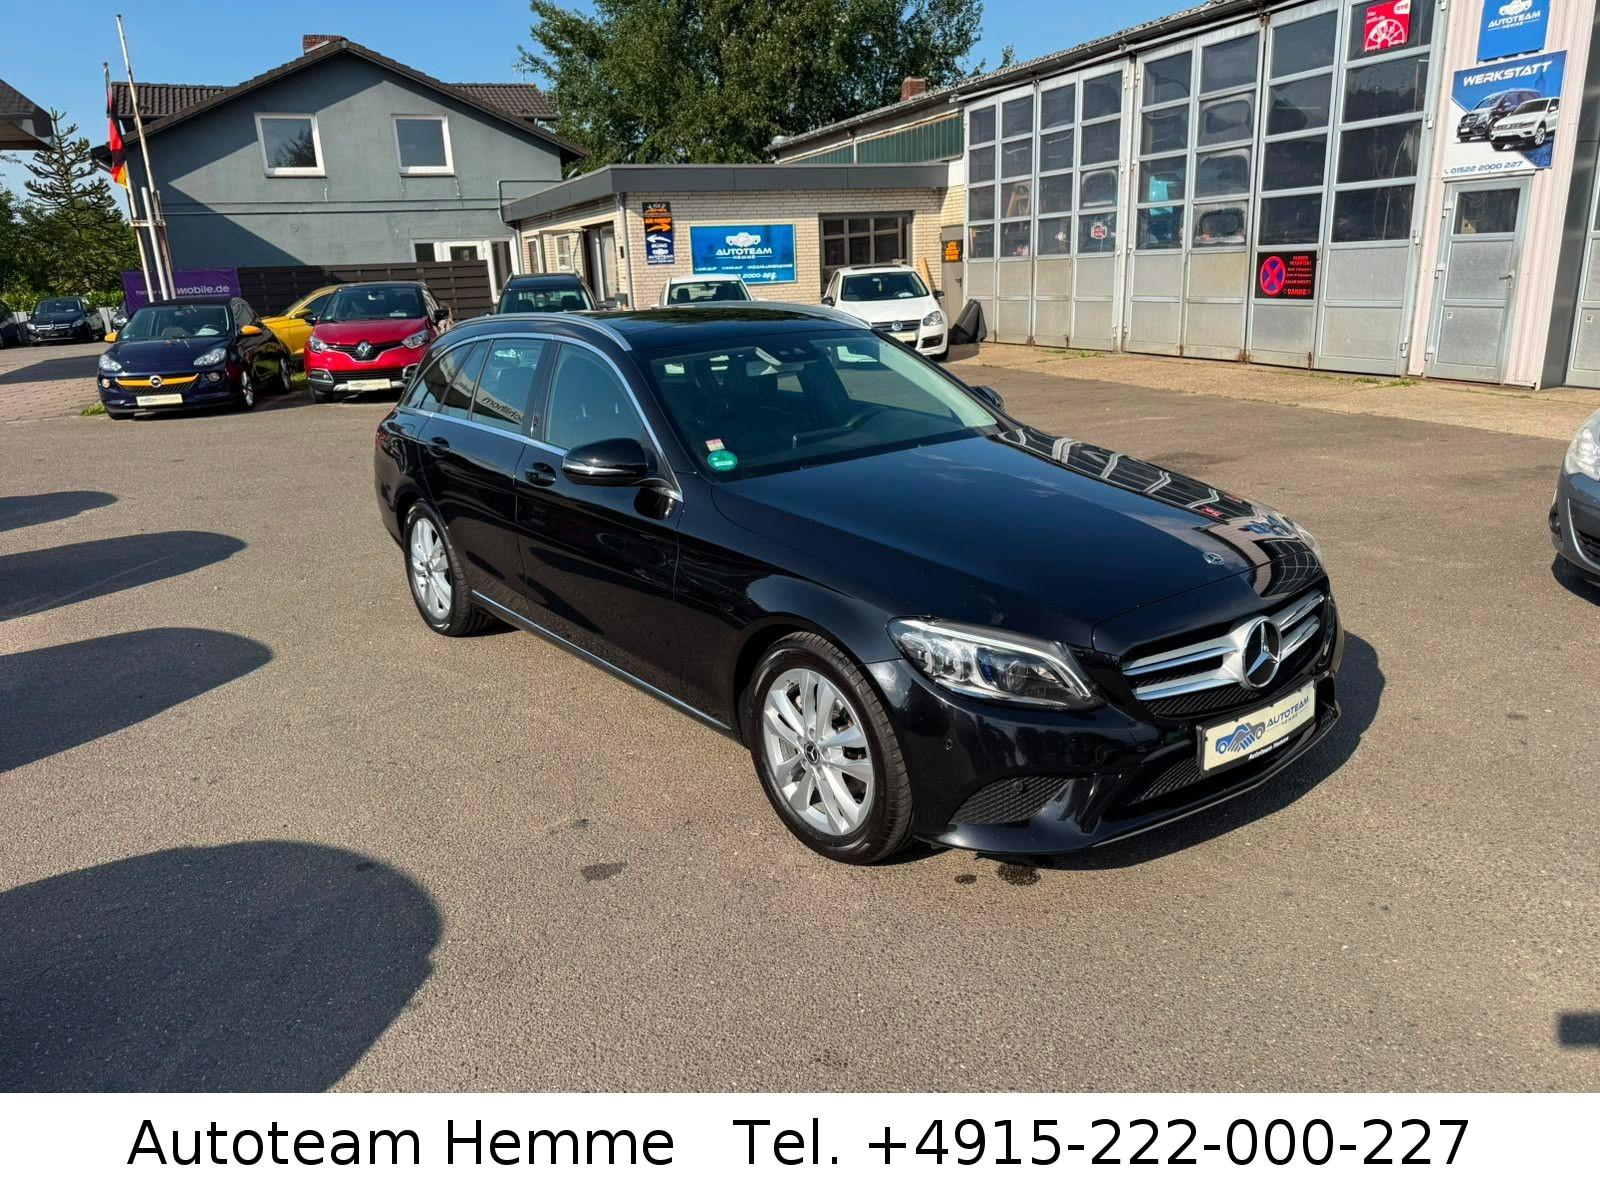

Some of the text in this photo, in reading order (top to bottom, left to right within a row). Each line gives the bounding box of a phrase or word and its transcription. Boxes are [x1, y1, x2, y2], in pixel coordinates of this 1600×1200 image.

[1487, 9, 1541, 28] AUTOTEAM
[1463, 60, 1553, 87] WERKSTATT
[1450, 160, 1524, 174] 01522 2000 227
[715, 247, 773, 256] AUTOTEAM
[176, 284, 231, 295] mobile.de
[1266, 695, 1309, 728] AUTOTEAM
